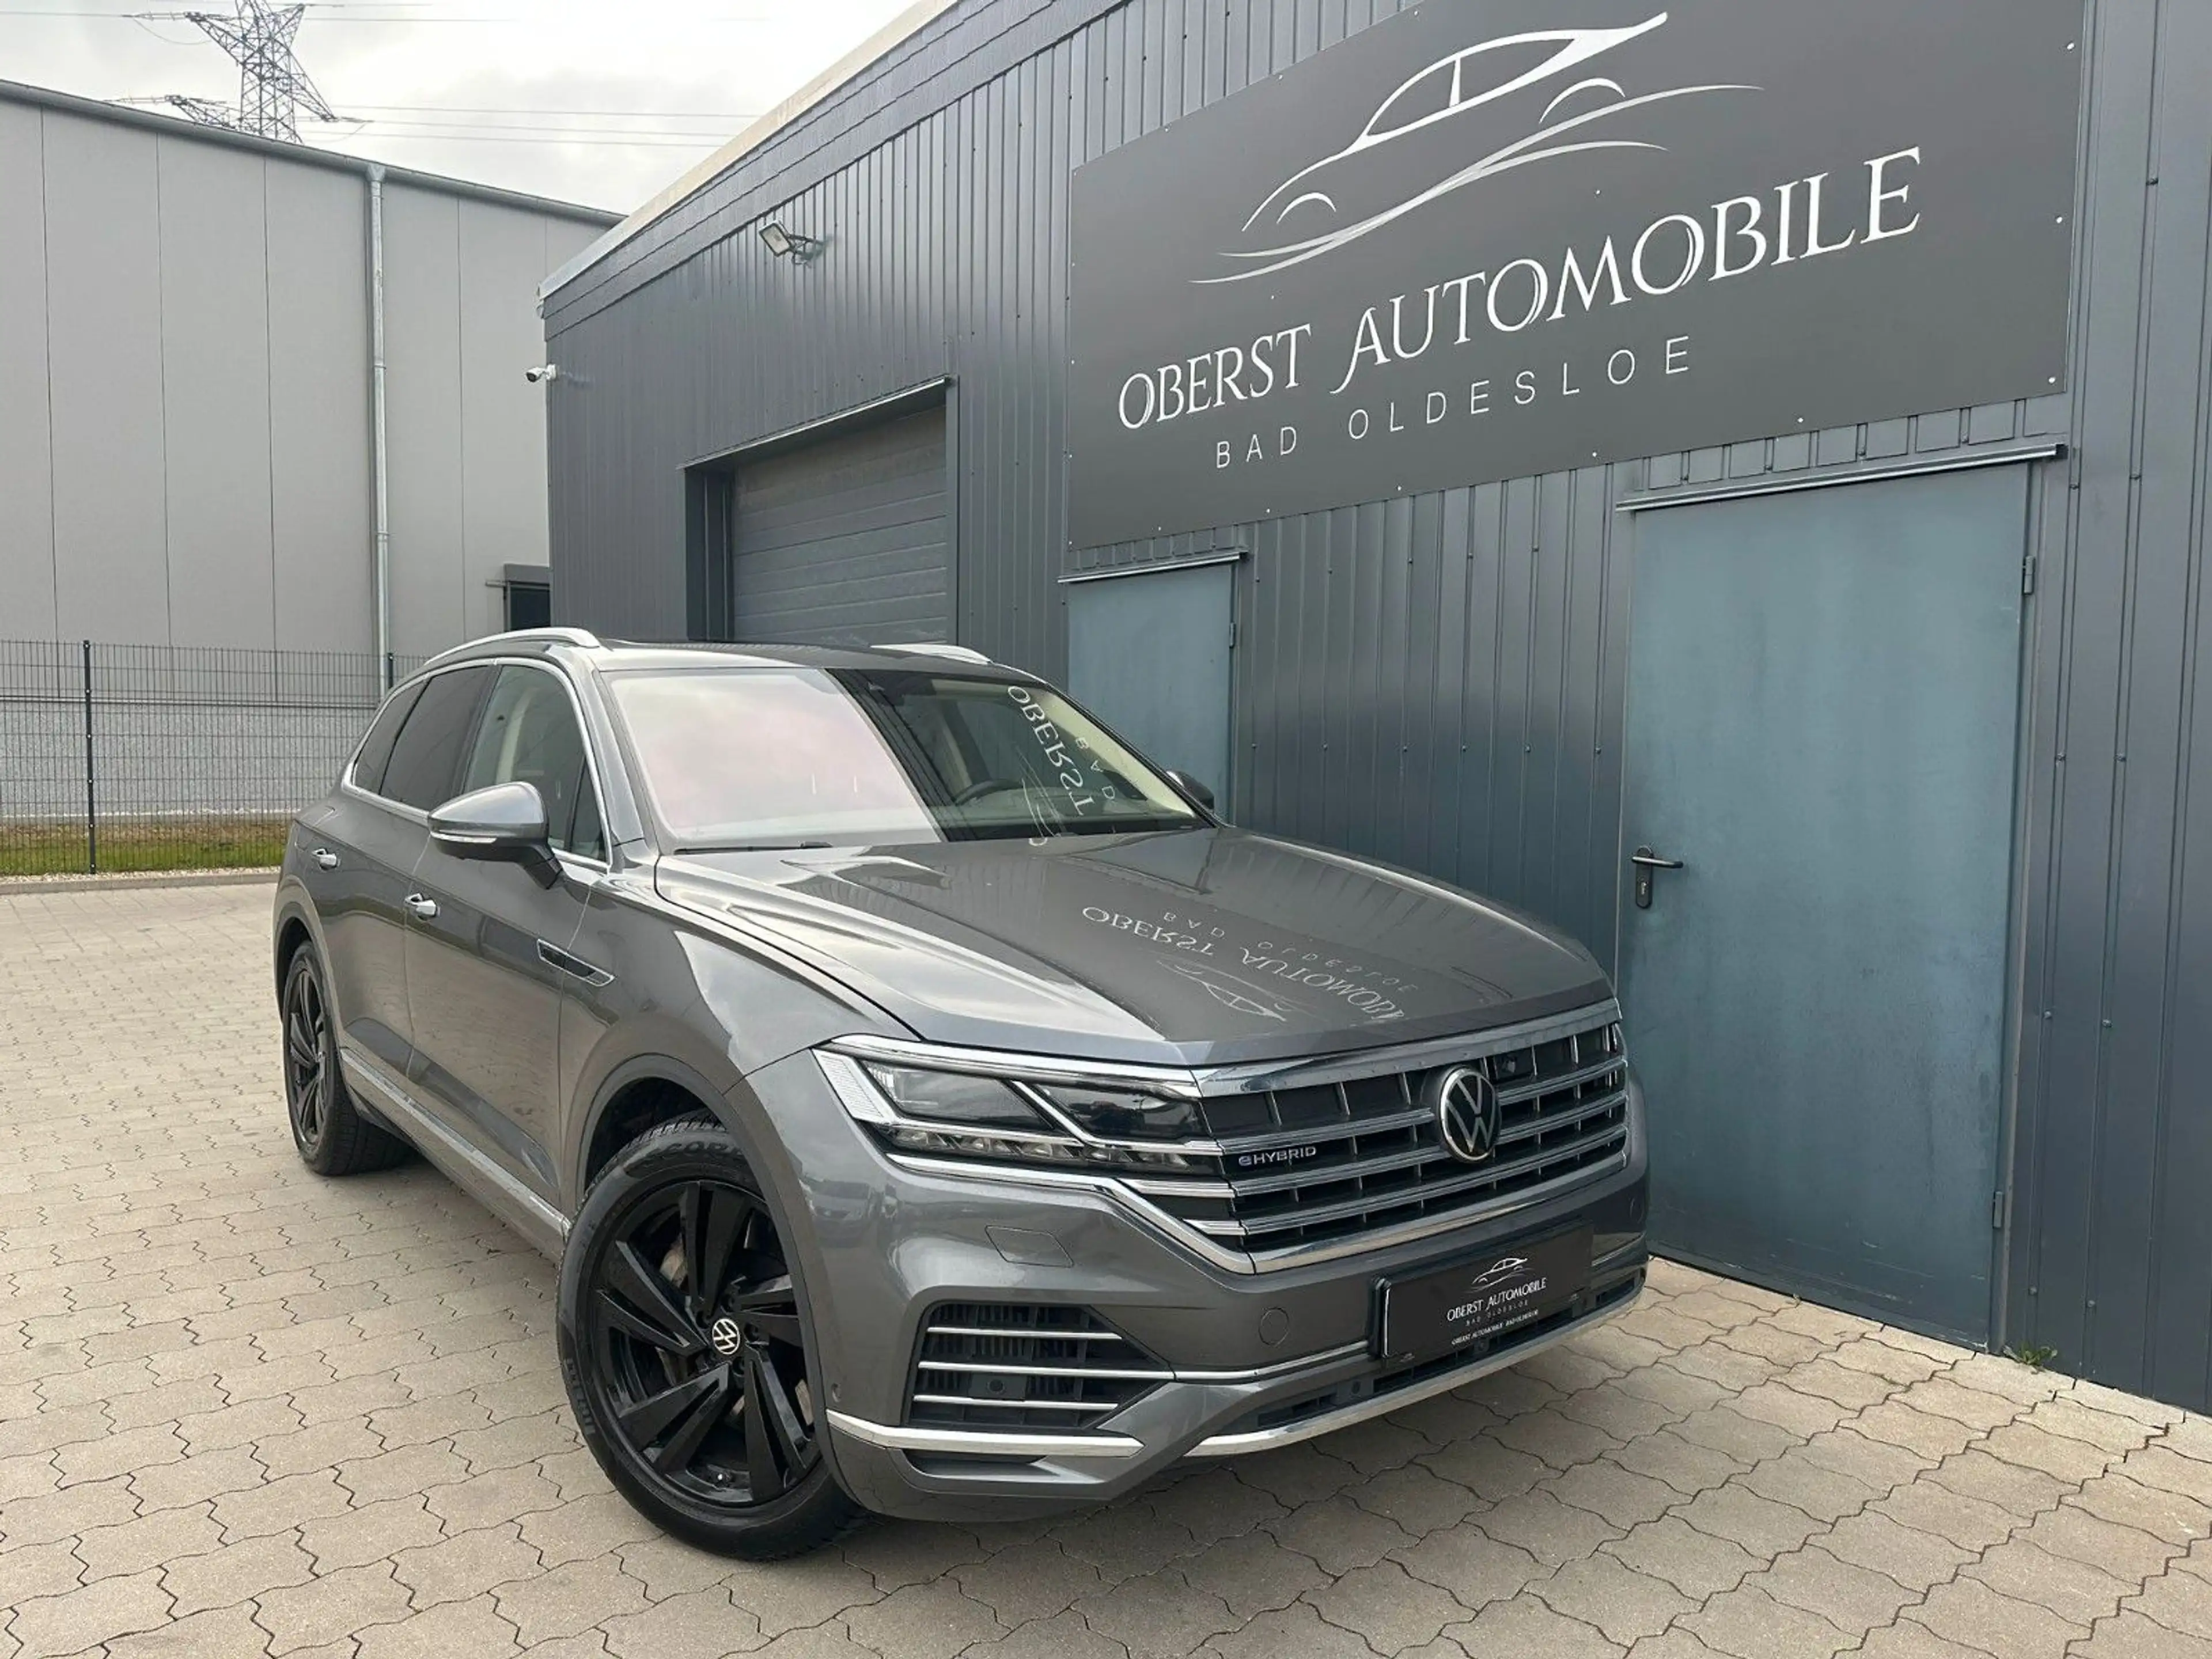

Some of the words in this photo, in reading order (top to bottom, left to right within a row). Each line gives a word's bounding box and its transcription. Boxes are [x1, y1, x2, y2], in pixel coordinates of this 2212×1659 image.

[1119, 323, 1312, 430] OBERST
[1330, 146, 1921, 394] AUTOMOBILE
[1215, 426, 1297, 469] BAD
[1347, 335, 1690, 440] OLDESLOE
[1446, 1299, 1484, 1322] OBERST
[1485, 1277, 1548, 1311] AUTOMOBILE
